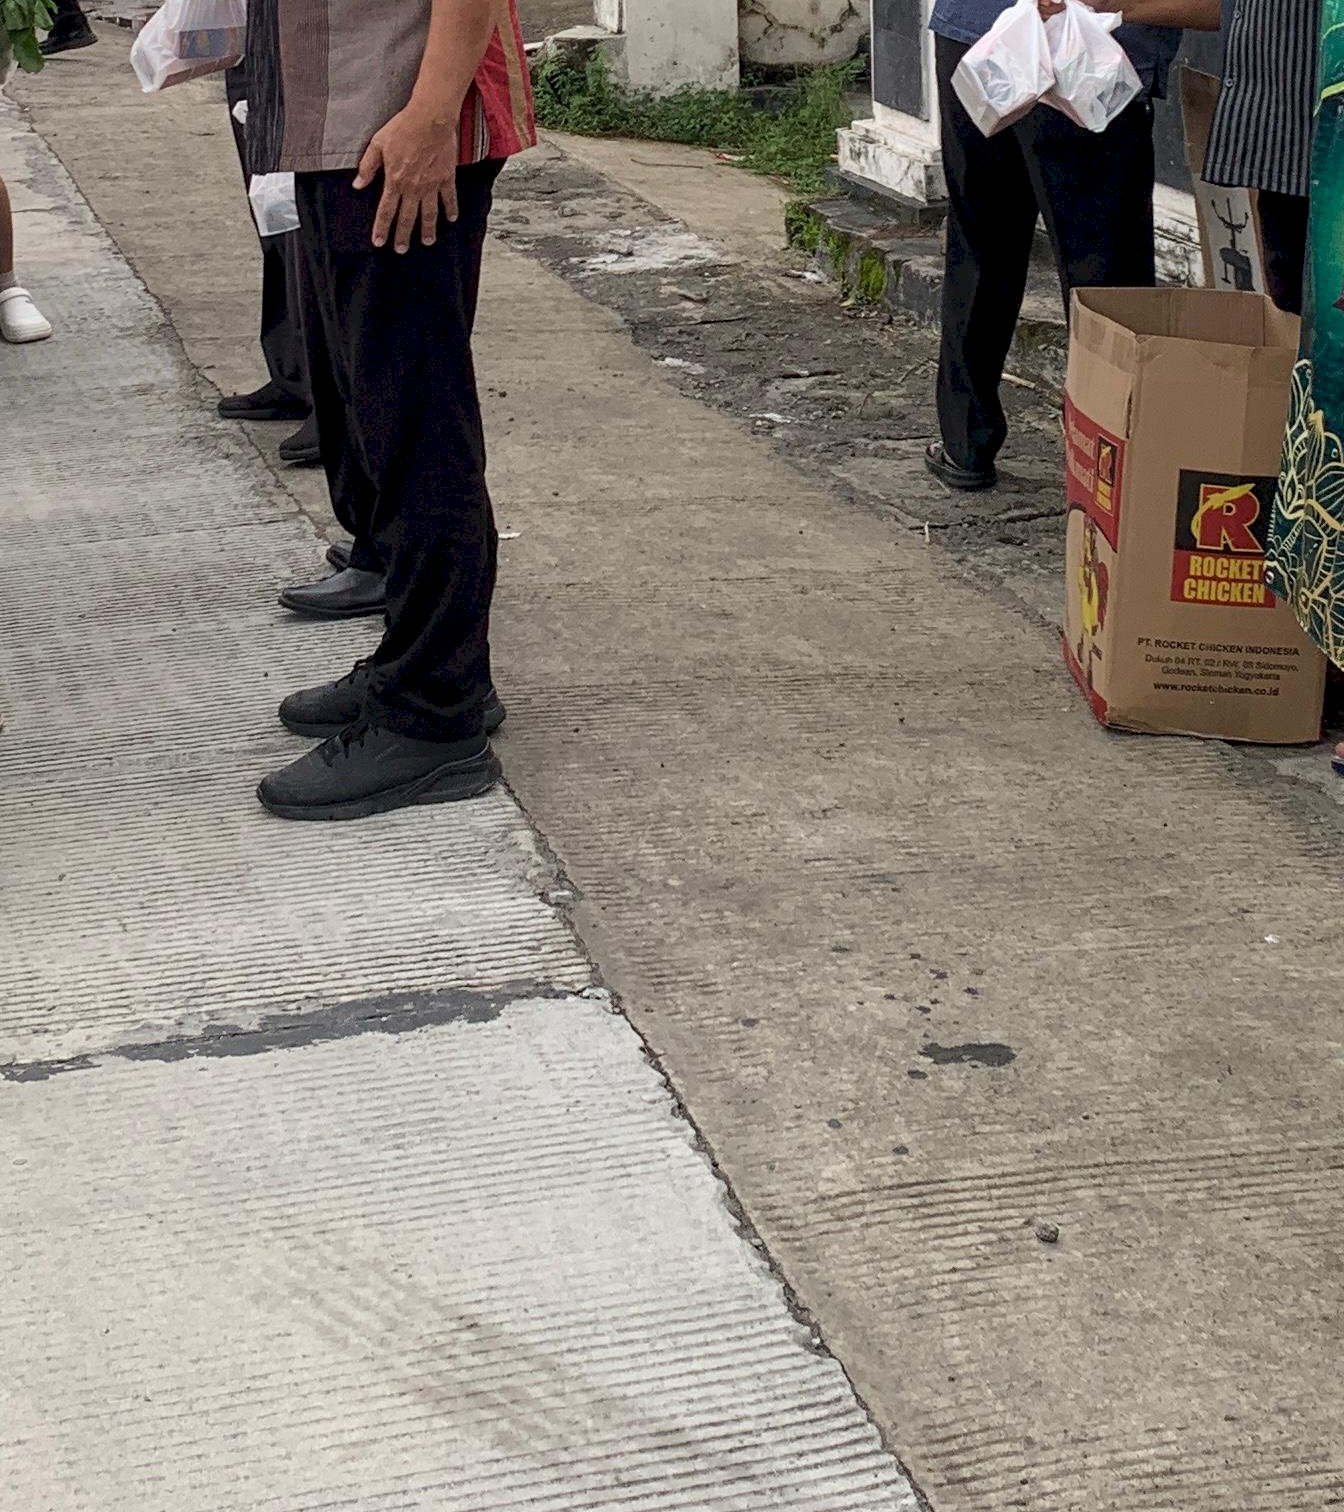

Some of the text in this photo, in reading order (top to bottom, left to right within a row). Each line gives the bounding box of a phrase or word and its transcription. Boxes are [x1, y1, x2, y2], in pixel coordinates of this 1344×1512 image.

[1189, 555, 1264, 581] ROCKET
[1183, 578, 1265, 604] CHICKEN
[1137, 637, 1300, 657] PT. ROCKET CHICKEN INDONESIA
[1153, 681, 1280, 697] www.rocketchicken.co.id
